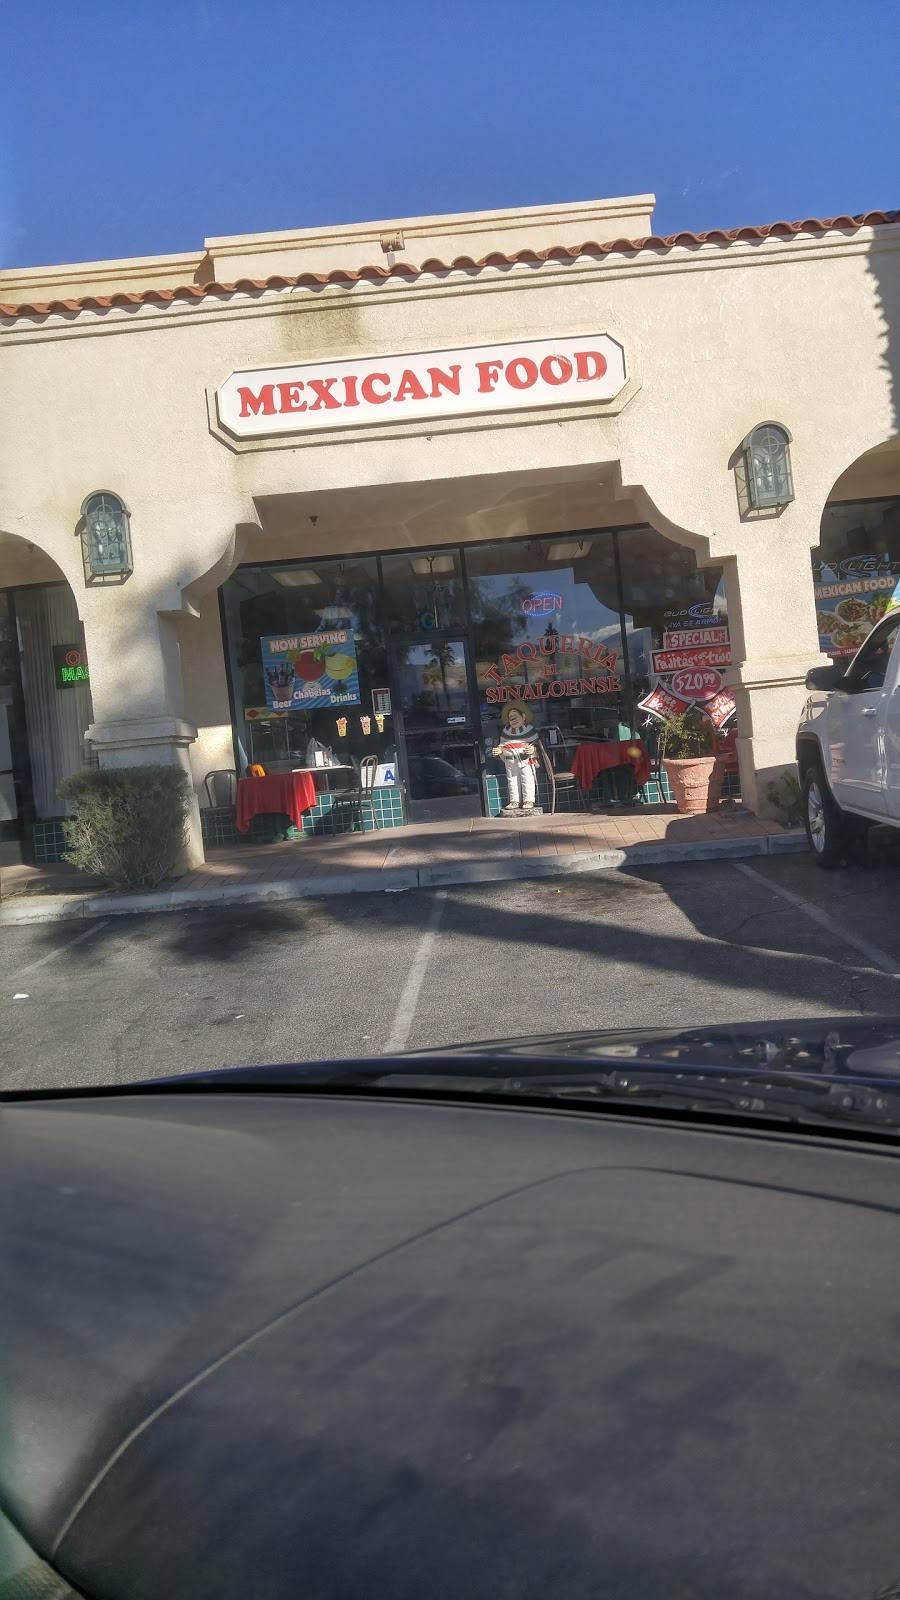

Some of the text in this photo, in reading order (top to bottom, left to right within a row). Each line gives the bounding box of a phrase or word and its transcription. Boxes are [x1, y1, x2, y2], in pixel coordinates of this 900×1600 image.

[237, 351, 608, 418] MEXICAN FOOD
[815, 577, 895, 599] MEXICAN FOOD
[522, 597, 562, 612] OPEN
[270, 631, 347, 653] NOW SERVING
[484, 634, 619, 685] TAQUERIA
[543, 664, 560, 676] EL
[293, 688, 331, 700] Chabelas
[485, 675, 622, 703] SINALOENSE
[272, 700, 292, 709] Beer
[330, 692, 357, 704] Drinks
[383, 768, 396, 782] A
